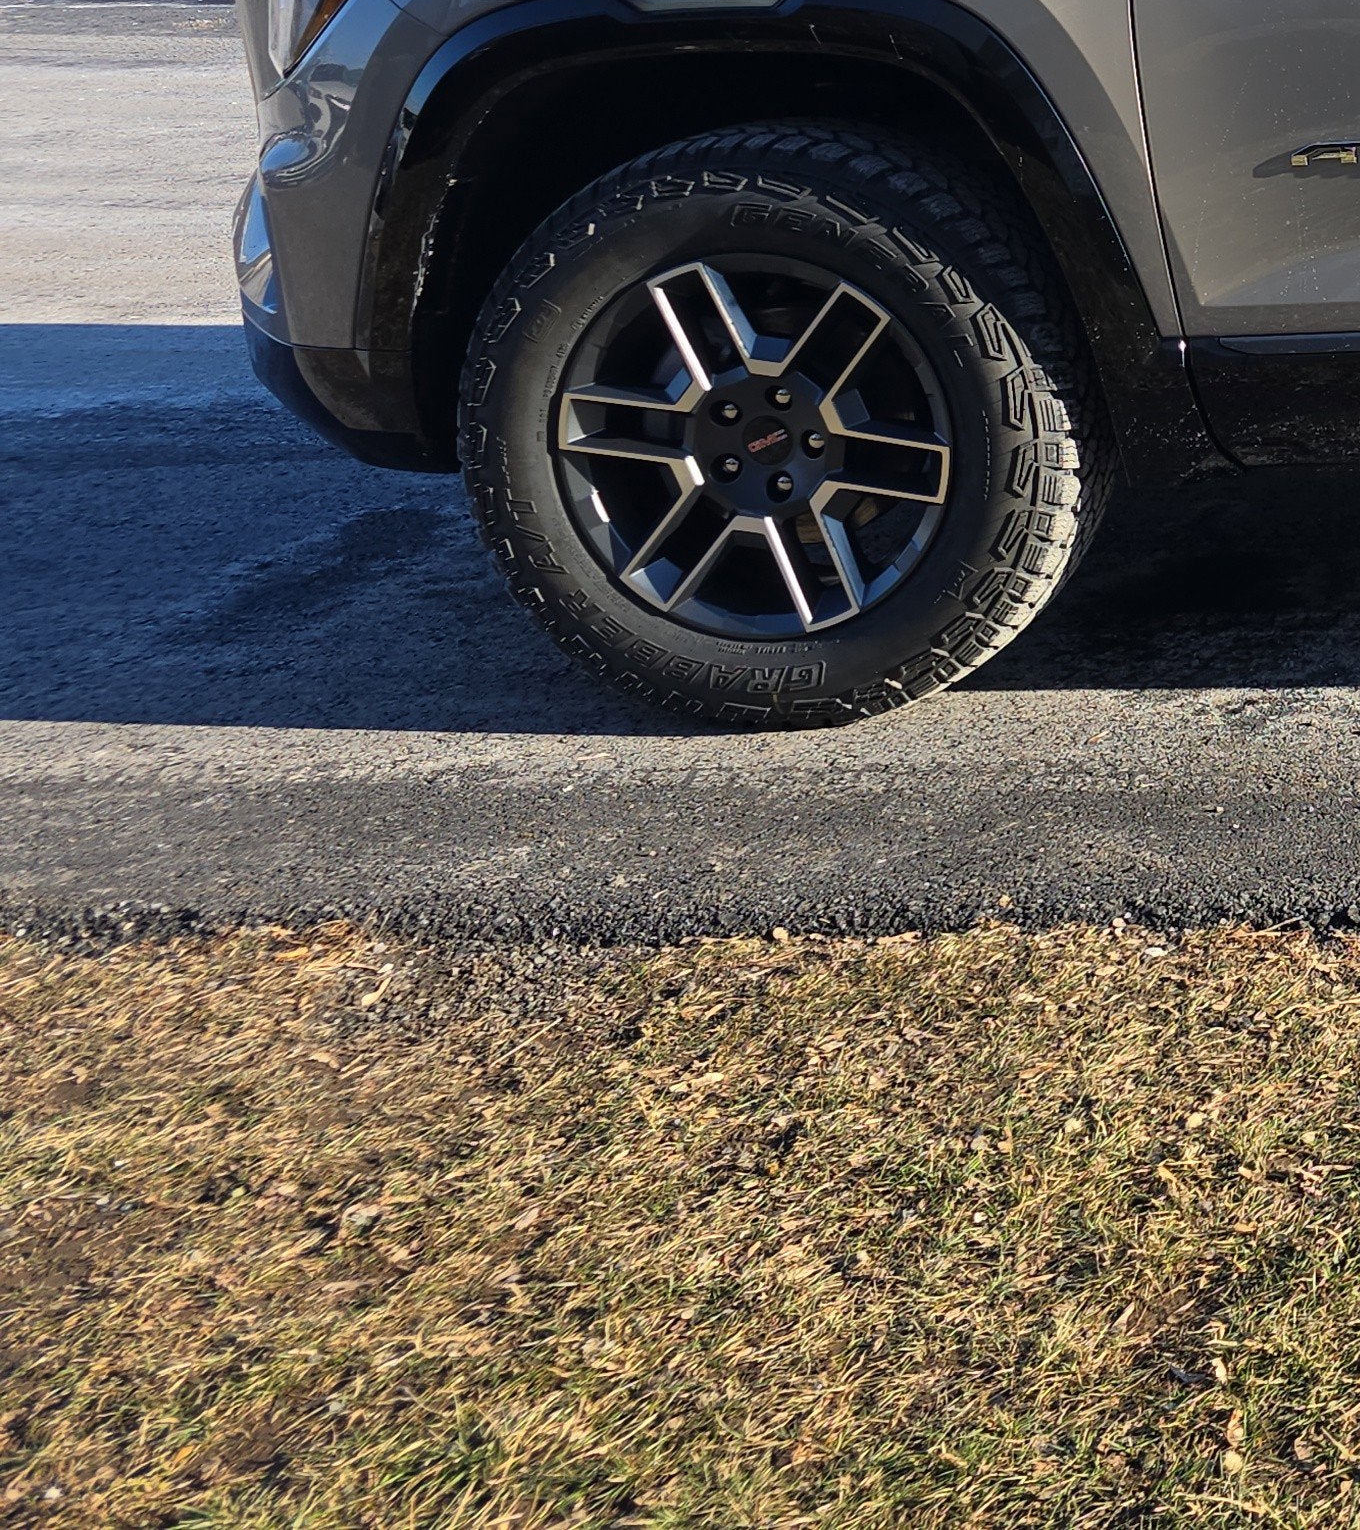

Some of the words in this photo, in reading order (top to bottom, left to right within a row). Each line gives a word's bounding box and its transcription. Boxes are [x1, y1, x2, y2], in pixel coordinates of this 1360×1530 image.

[730, 201, 973, 368] GENERAL
[747, 428, 788, 453] GMC
[558, 588, 827, 694] GRABBER
